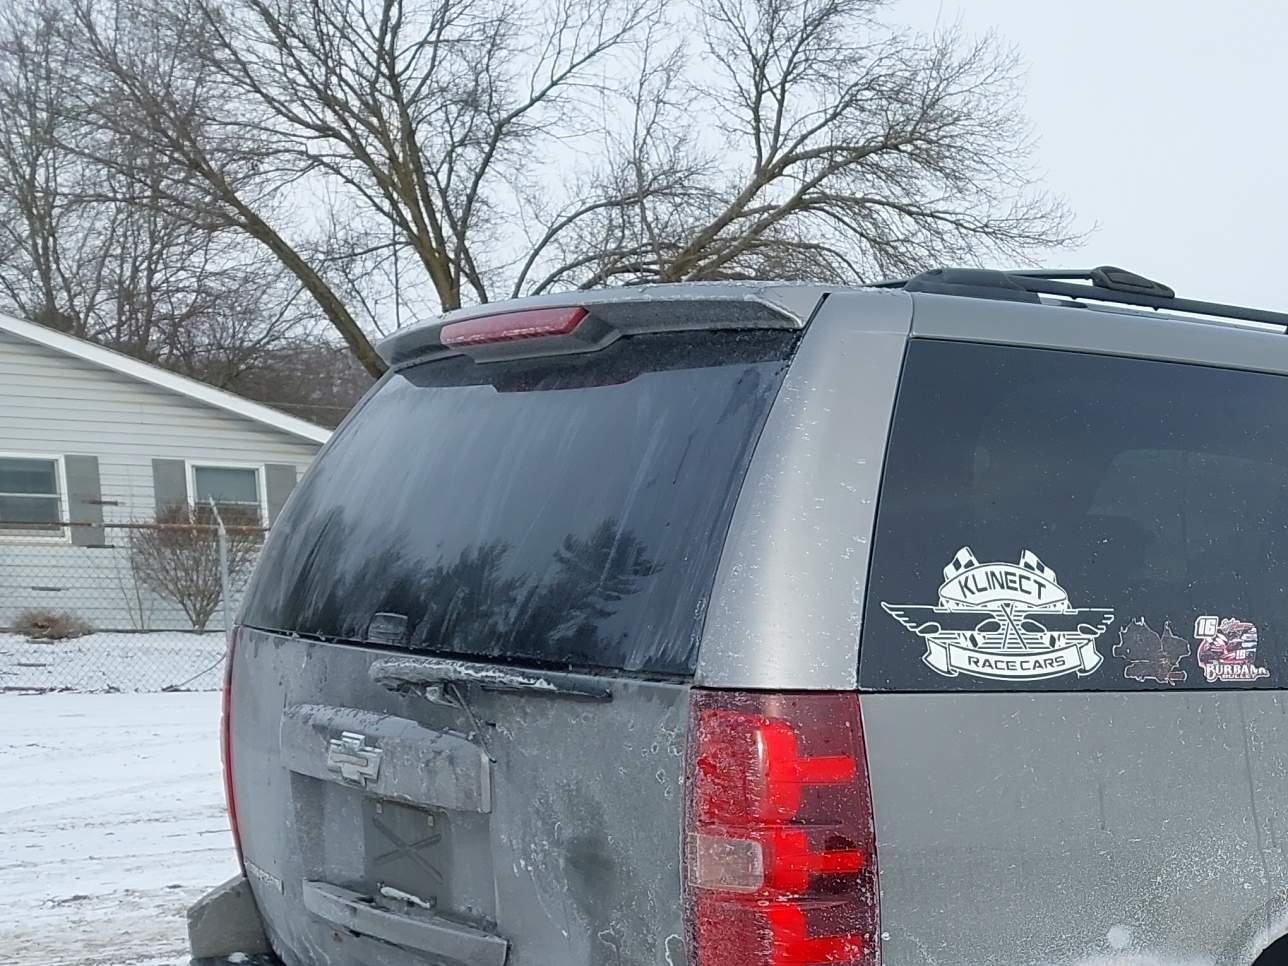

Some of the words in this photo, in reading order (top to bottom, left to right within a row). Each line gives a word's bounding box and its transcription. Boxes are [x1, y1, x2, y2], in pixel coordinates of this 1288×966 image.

[958, 570, 1046, 600] KLINECT
[1198, 618, 1217, 635] 16
[967, 655, 1018, 671] RACE
[1019, 655, 1066, 671] CARS
